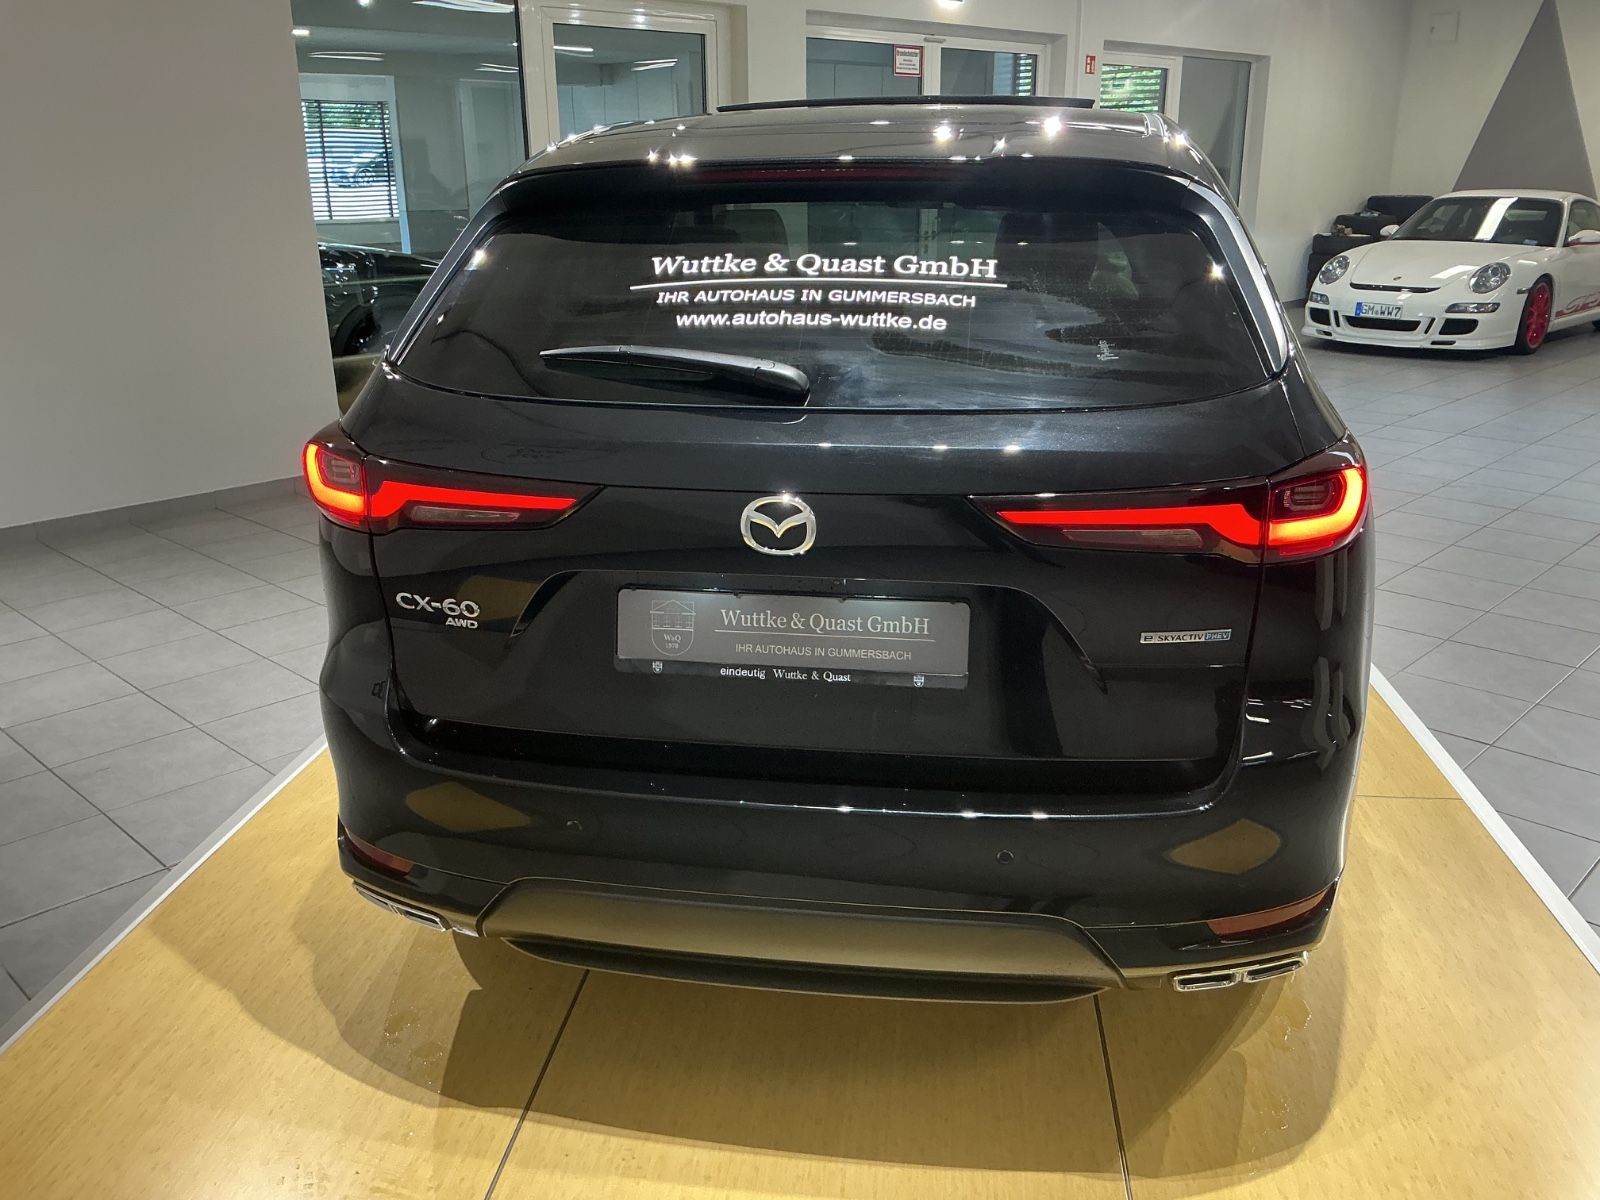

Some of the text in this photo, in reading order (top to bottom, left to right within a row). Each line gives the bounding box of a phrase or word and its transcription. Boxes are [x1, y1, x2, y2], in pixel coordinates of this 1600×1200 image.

[651, 253, 998, 279] Wuttke & Quast GmbH
[656, 288, 976, 307] IHR AUTOHAUS IN GUMMERSBACH
[675, 311, 947, 331] www.autohaus-wuttke.de
[395, 592, 480, 618] CX-60
[445, 617, 478, 629] AWD
[720, 608, 930, 635] Wuttke & Quast GmbH
[1157, 633, 1204, 642] SKYACTIV
[735, 643, 912, 661] IHR AUTOHAUS IN GUMMERSBACH
[720, 666, 851, 682] eindeutig Wuttke & Quast
